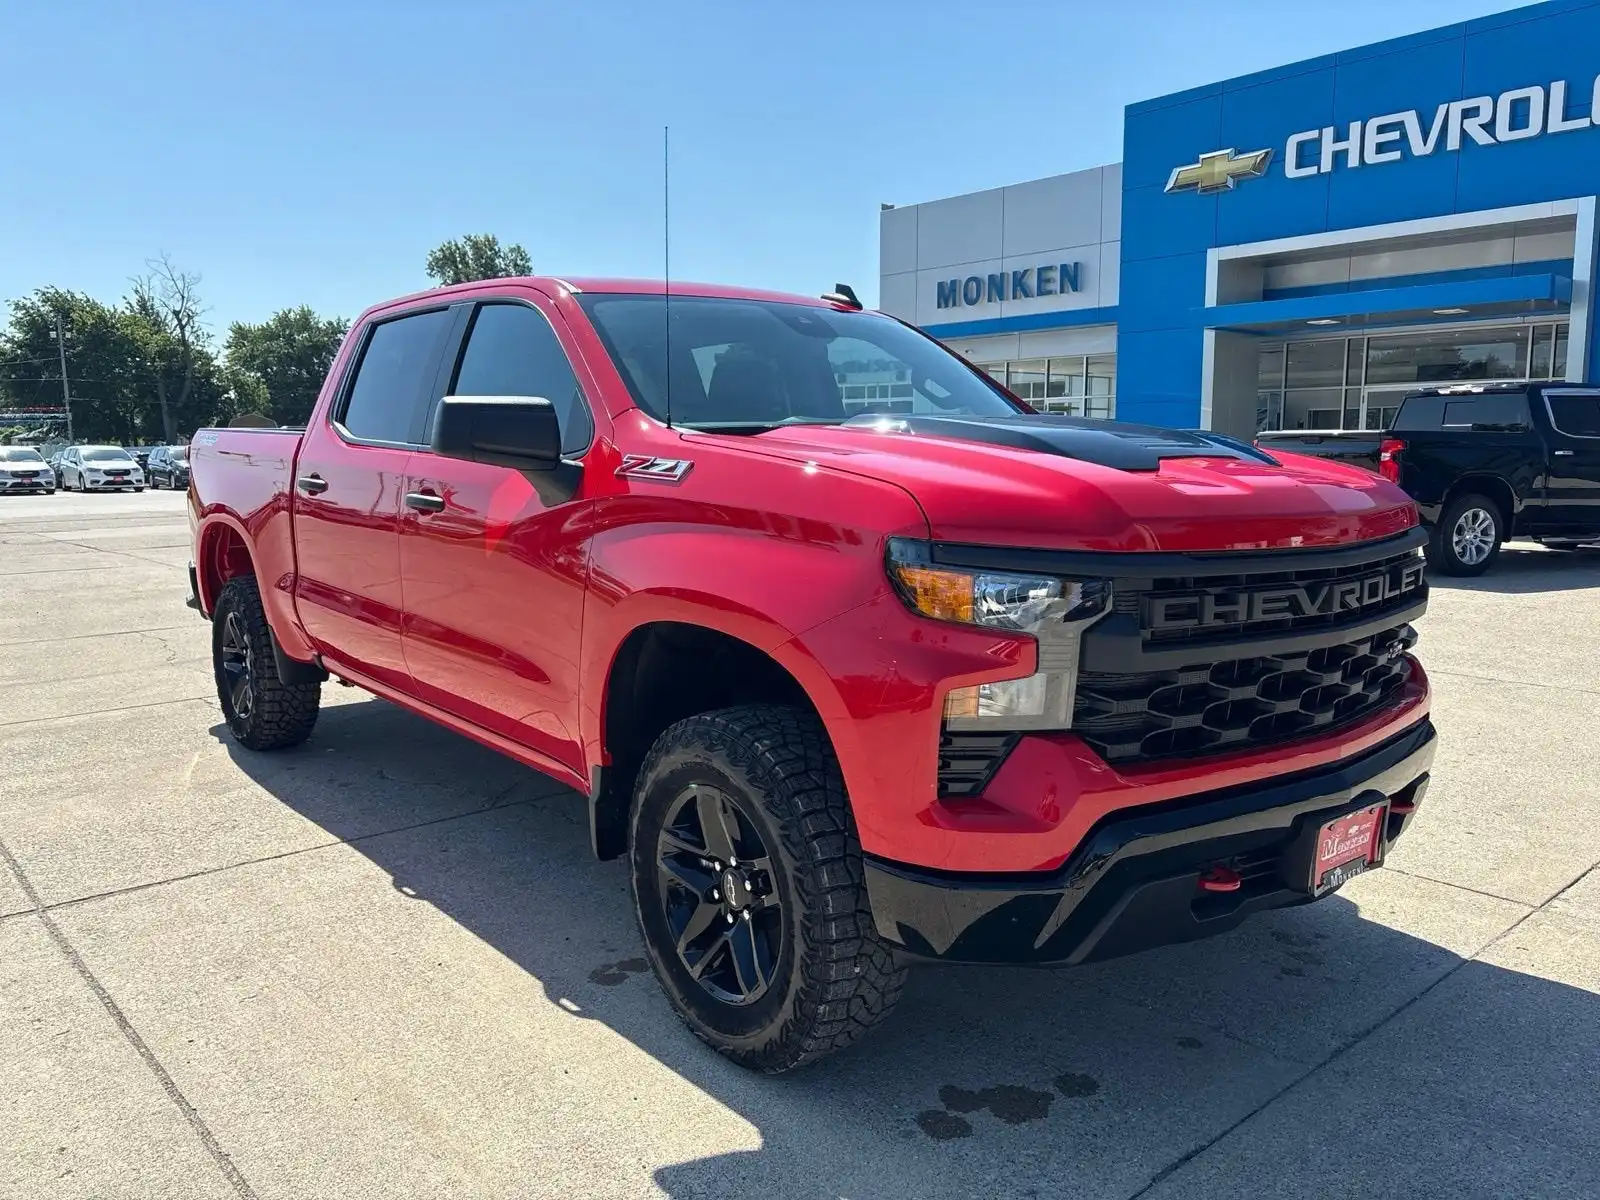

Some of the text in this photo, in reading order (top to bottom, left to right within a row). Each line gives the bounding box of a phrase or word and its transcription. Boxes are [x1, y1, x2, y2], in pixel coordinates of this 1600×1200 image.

[1285, 74, 1600, 178] CHEVROL
[937, 262, 1082, 309] MONKEN
[614, 454, 695, 482] Z71
[1152, 562, 1427, 628] CHEVROLET
